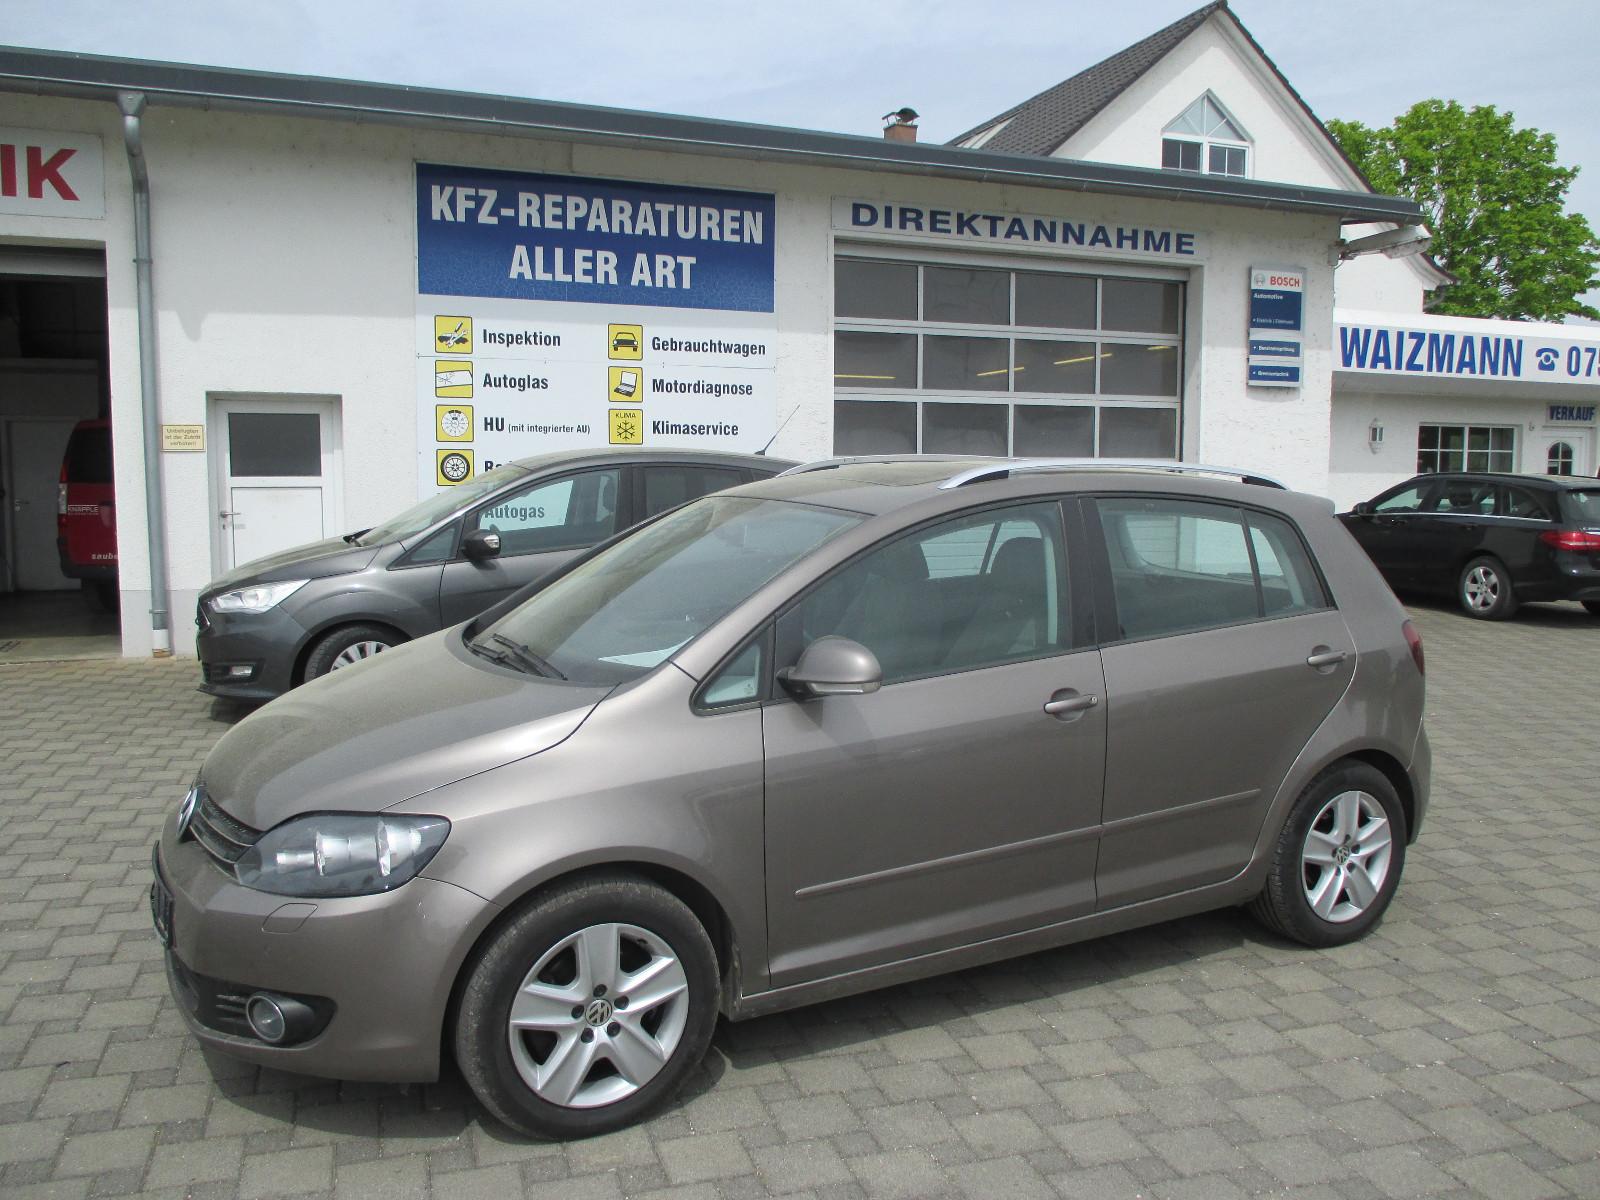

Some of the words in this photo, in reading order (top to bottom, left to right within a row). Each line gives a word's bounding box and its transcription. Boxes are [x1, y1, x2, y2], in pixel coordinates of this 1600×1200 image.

[431, 184, 763, 245] KFZ-REPARATUREN
[851, 202, 1195, 255] DIREKTANNAHME
[509, 245, 618, 285] ALLER
[630, 253, 697, 289] ART
[1270, 276, 1300, 287] BOSCH
[483, 329, 561, 348] Inspektion
[651, 336, 766, 357] Gebrauchtwagen
[1339, 326, 1523, 377] WAIZMANN
[1566, 346, 1600, 377] 07
[483, 373, 549, 392] Autoglas
[652, 378, 753, 397] Motordiagnose
[1550, 405, 1595, 421] VERKAUF
[483, 416, 505, 432] HU
[508, 423, 525, 434] (mit
[527, 423, 574, 435] integrierter
[576, 424, 591, 435] AU)
[652, 420, 739, 436] Klimaservice
[484, 505, 545, 521] Autogas
